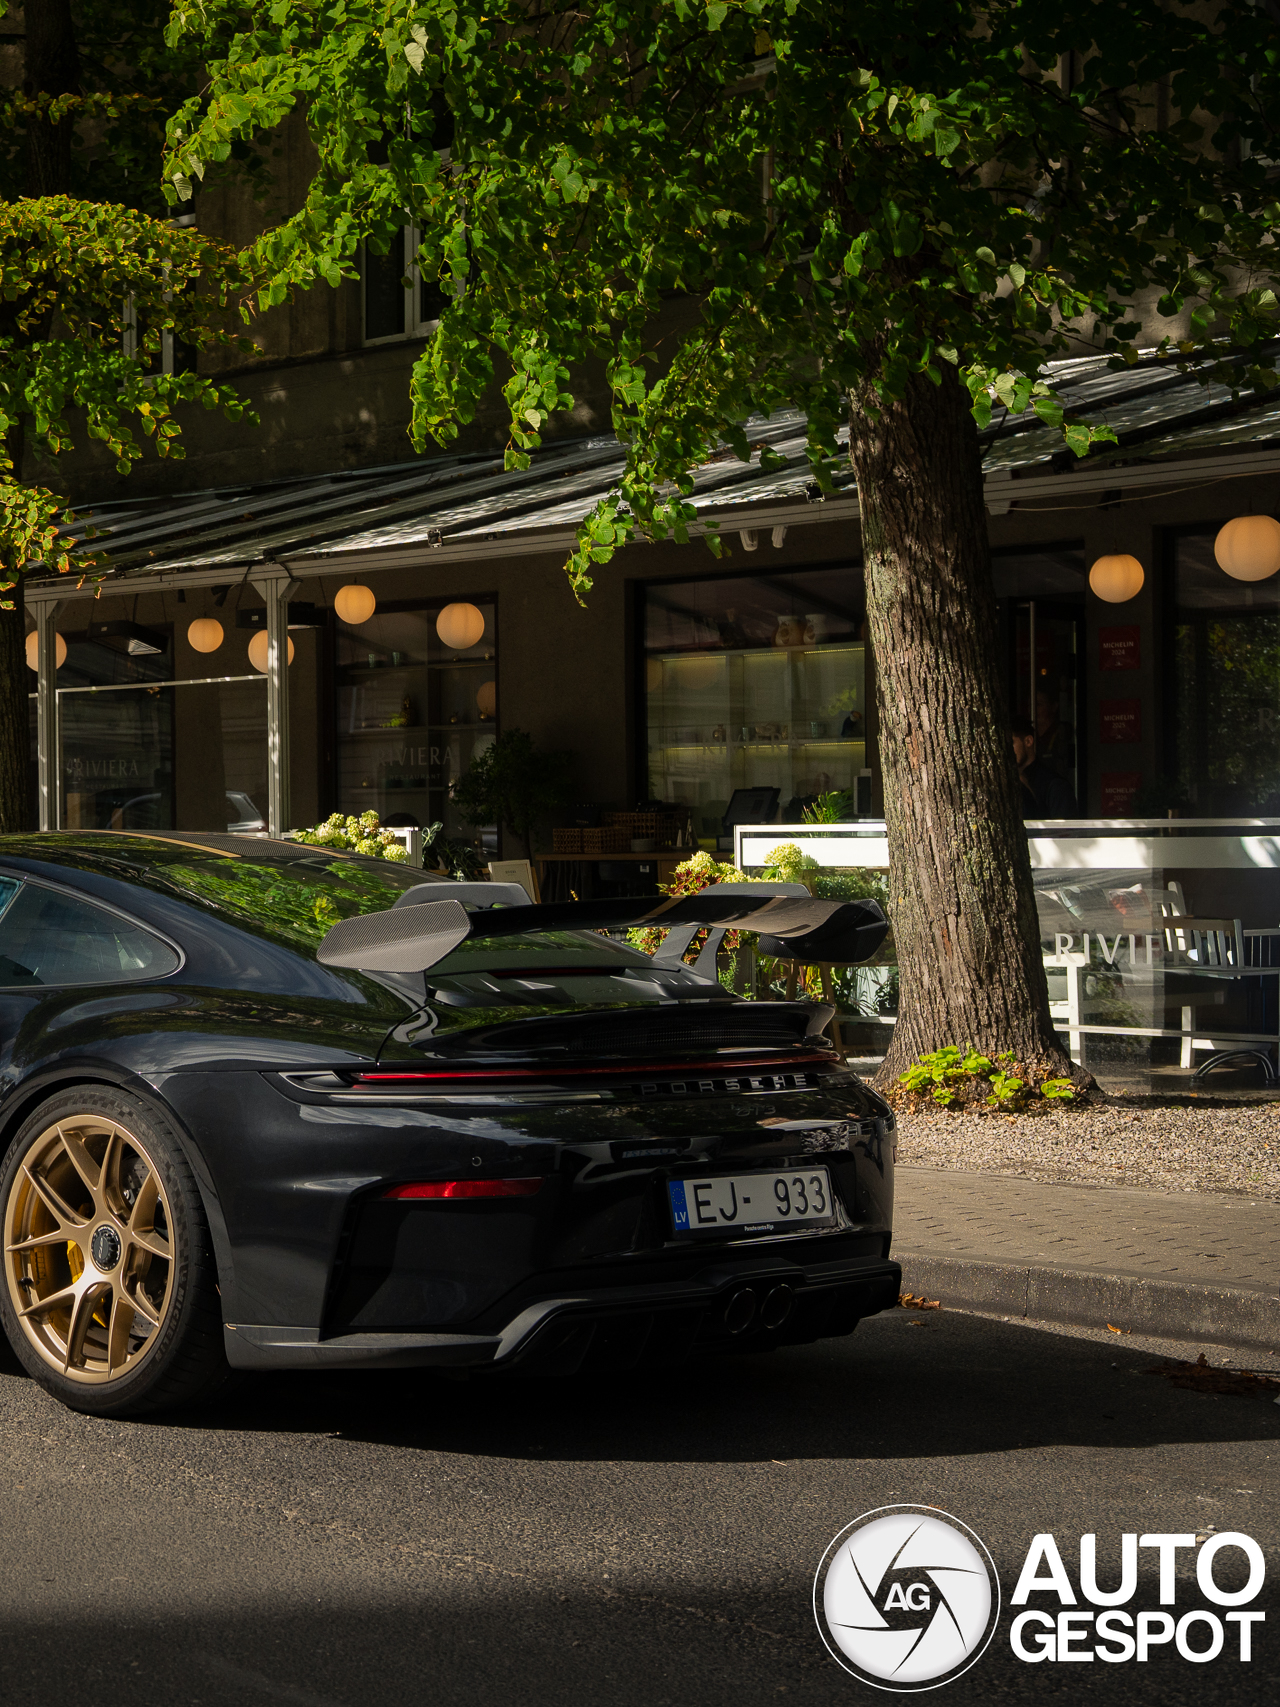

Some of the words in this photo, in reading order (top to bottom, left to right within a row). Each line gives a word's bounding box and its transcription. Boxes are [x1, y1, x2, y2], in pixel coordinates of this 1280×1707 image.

[379, 746, 454, 766] RIVIERA
[77, 760, 139, 777] RIVIERA
[641, 1074, 807, 1096] PORSCHE
[736, 1105, 777, 1117] GT3
[674, 1211, 687, 1223] LV
